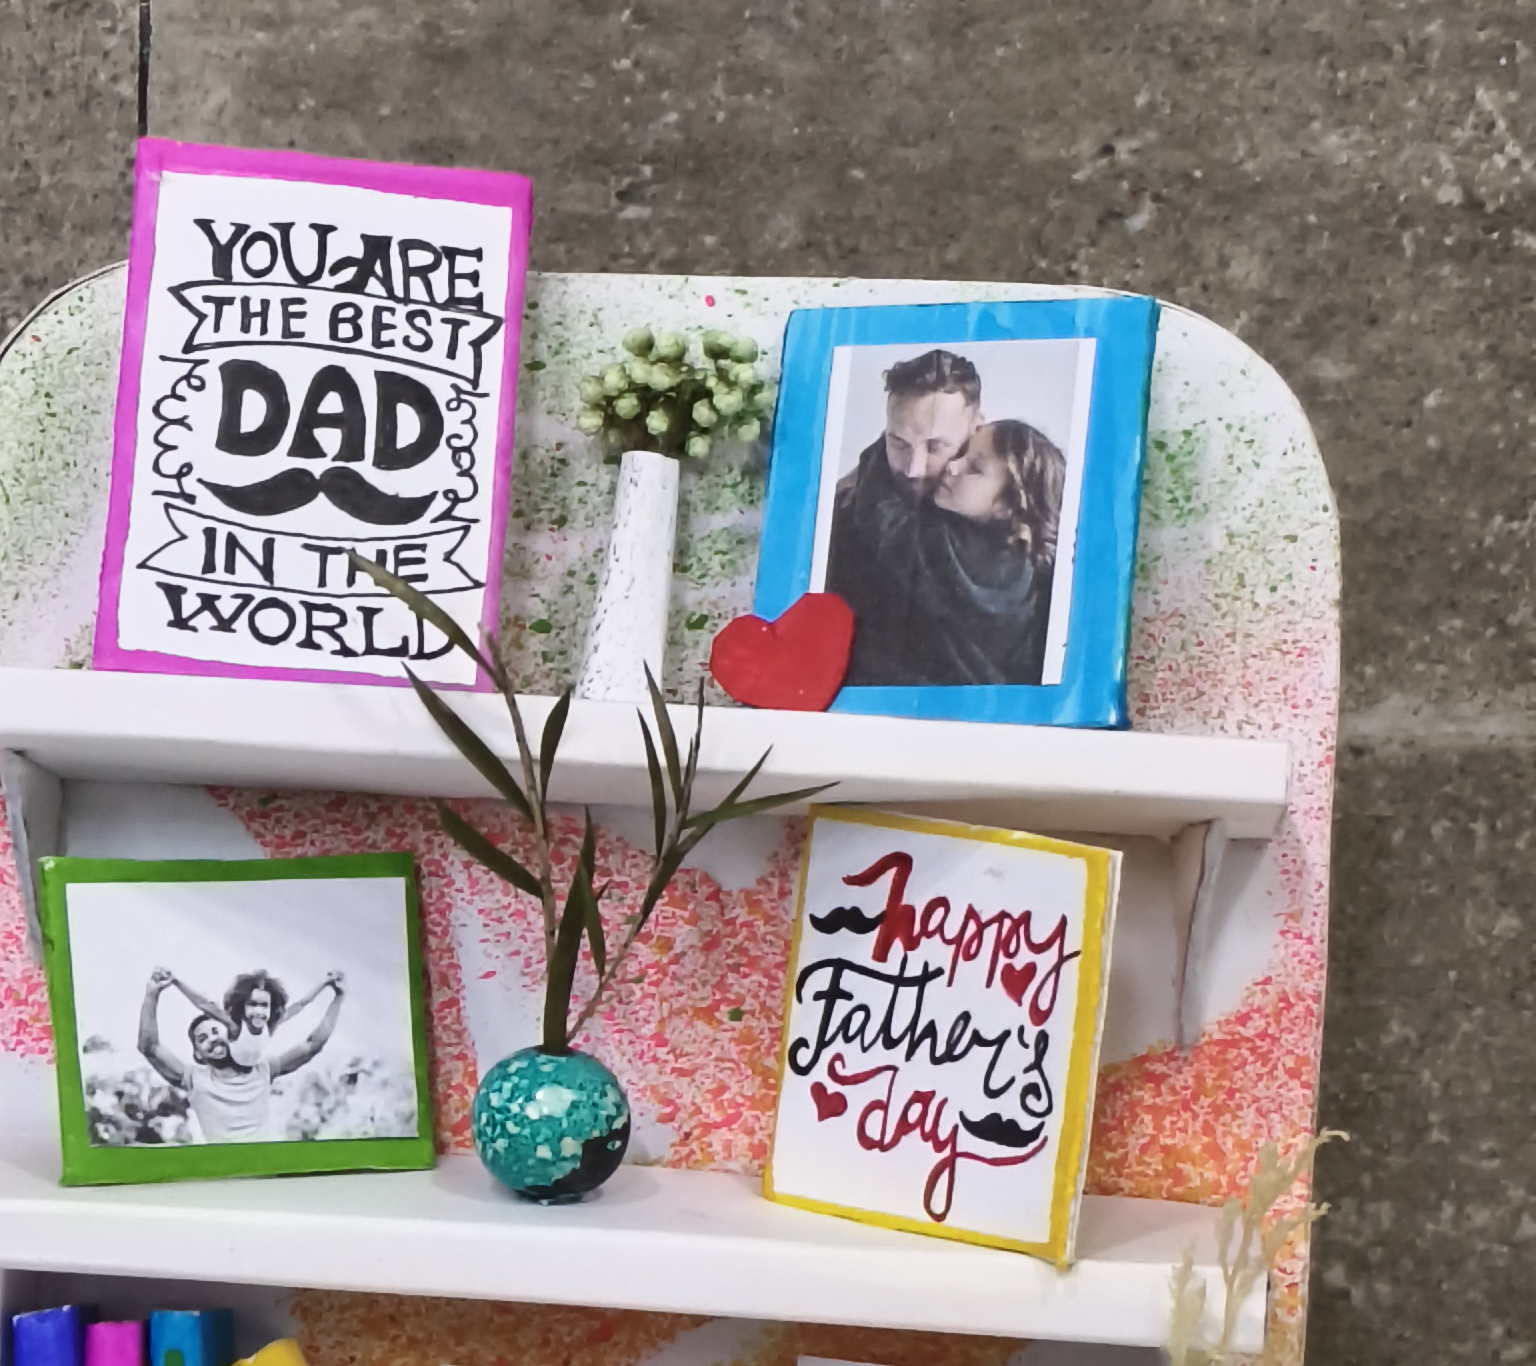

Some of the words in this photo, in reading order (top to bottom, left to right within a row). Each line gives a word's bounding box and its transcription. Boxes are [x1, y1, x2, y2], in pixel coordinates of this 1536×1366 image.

[194, 219, 337, 285] YOU
[328, 233, 483, 312] ARE
[203, 295, 308, 339] THE
[328, 301, 470, 361] BEST
[215, 359, 444, 471] DAD
[200, 526, 275, 587] IN
[303, 543, 428, 588] THE
[155, 580, 454, 661] WORLD
[842, 852, 1080, 1026] happy
[788, 954, 1054, 1118] Father's
[827, 1053, 1048, 1223] day
